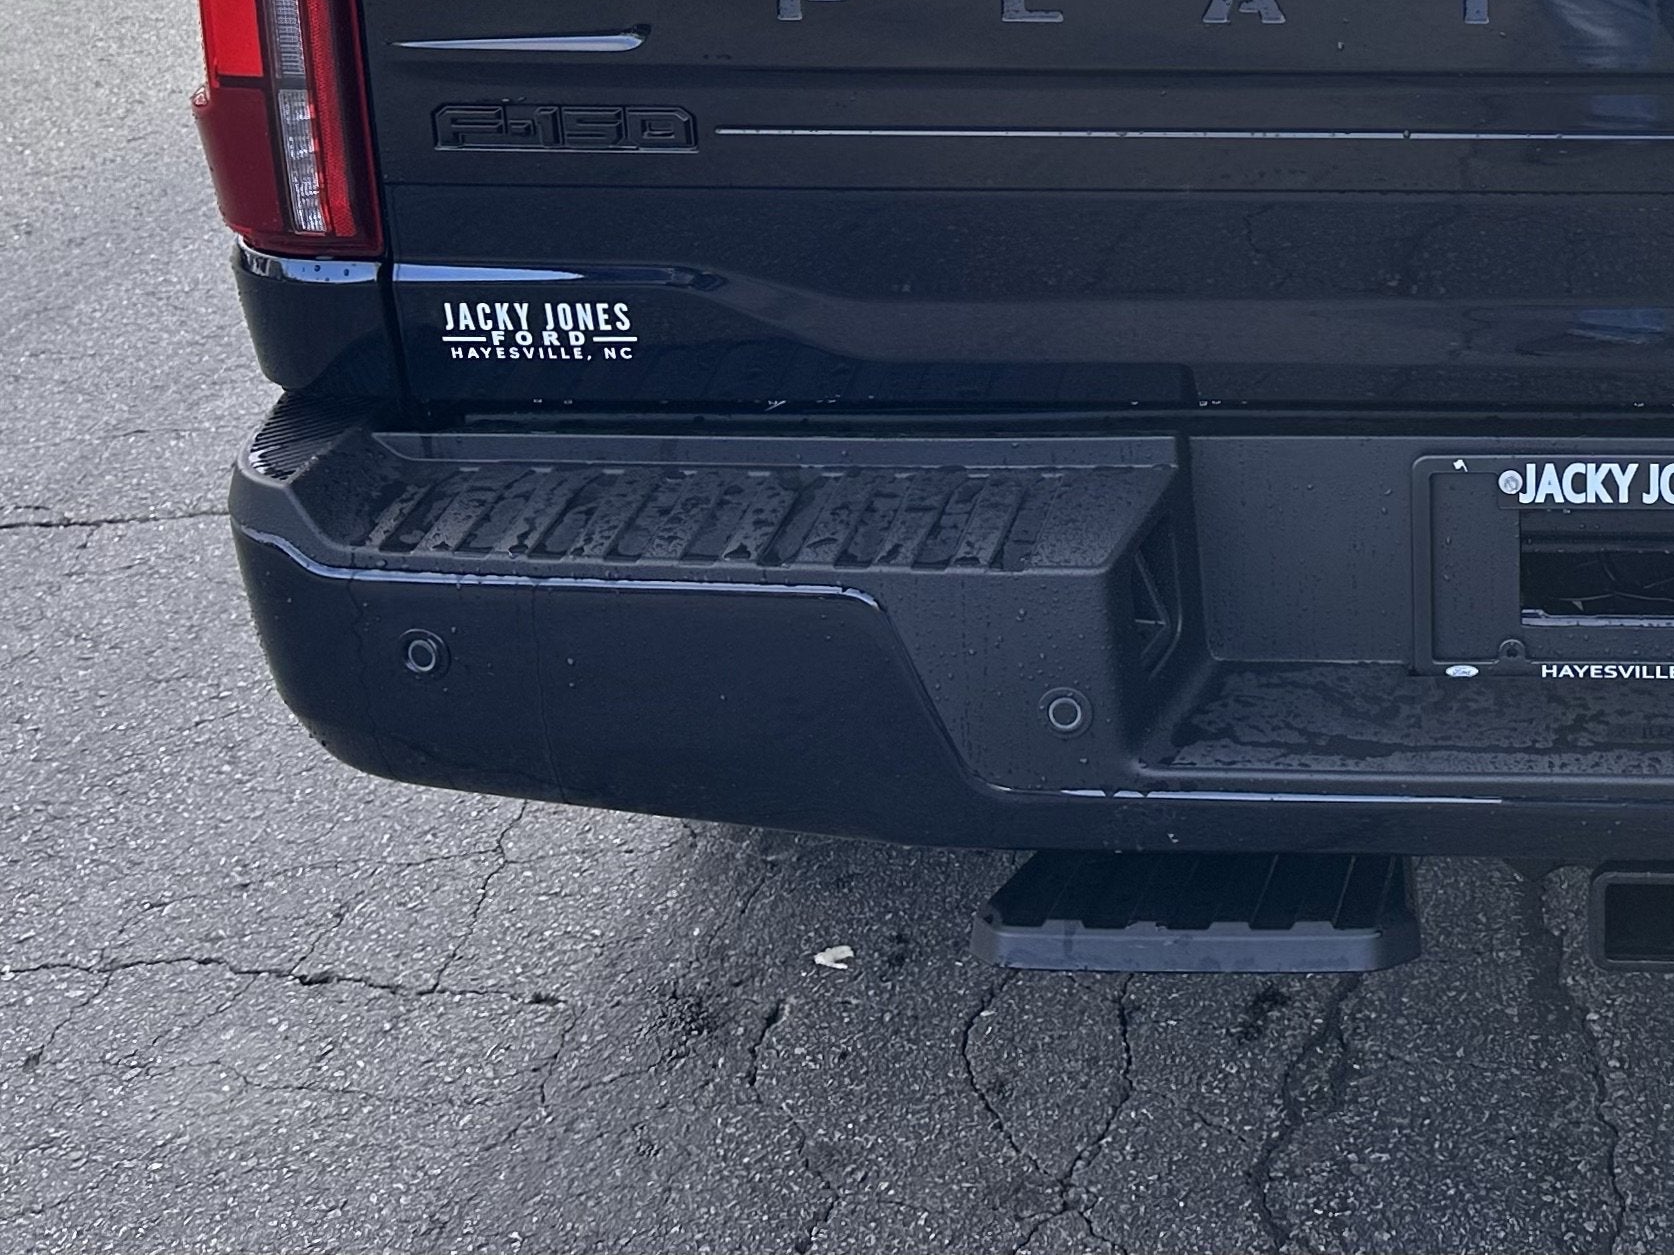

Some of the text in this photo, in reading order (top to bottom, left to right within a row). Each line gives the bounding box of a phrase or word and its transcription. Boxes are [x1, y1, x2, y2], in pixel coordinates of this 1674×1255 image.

[432, 104, 699, 154] F-150
[444, 302, 631, 331] JACKY JONES
[490, 330, 586, 346] FORD
[450, 347, 633, 361] HAYESVILLE, NC
[1518, 463, 1639, 504] JACKY
